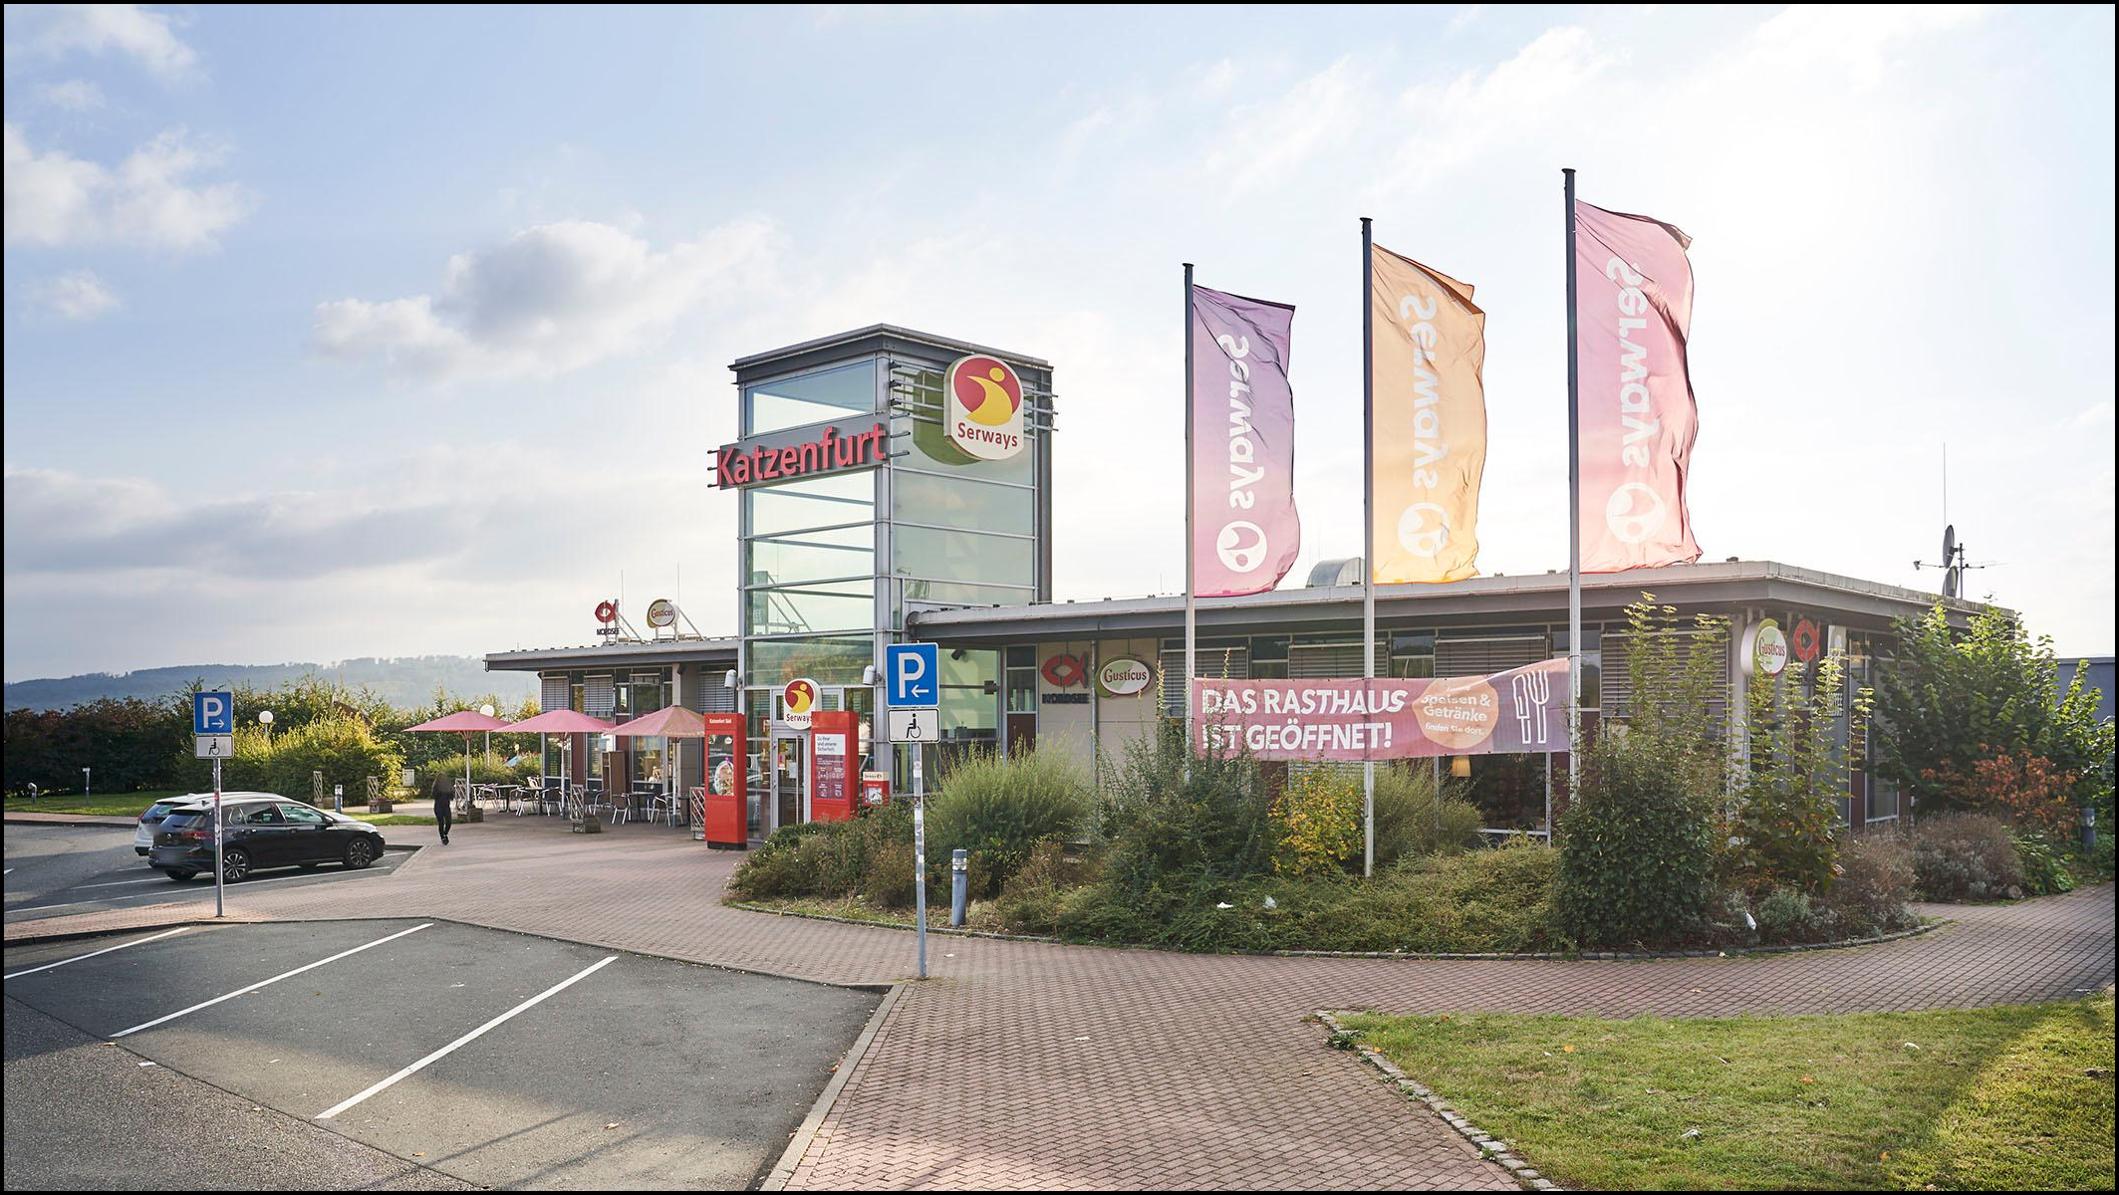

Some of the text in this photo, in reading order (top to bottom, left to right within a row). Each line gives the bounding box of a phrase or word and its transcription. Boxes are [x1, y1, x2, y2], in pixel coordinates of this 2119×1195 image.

[957, 422, 1018, 450] Serways
[717, 422, 887, 486] Katzenfurt
[898, 652, 926, 699] P
[1104, 668, 1147, 683] Gusticus
[203, 697, 223, 729] P
[1202, 689, 1409, 714] DAS RASTHAUS
[1421, 694, 1491, 707] Speisen &
[1424, 706, 1488, 722] Getränke
[1202, 718, 1392, 750] IST GEÖFFNET!
